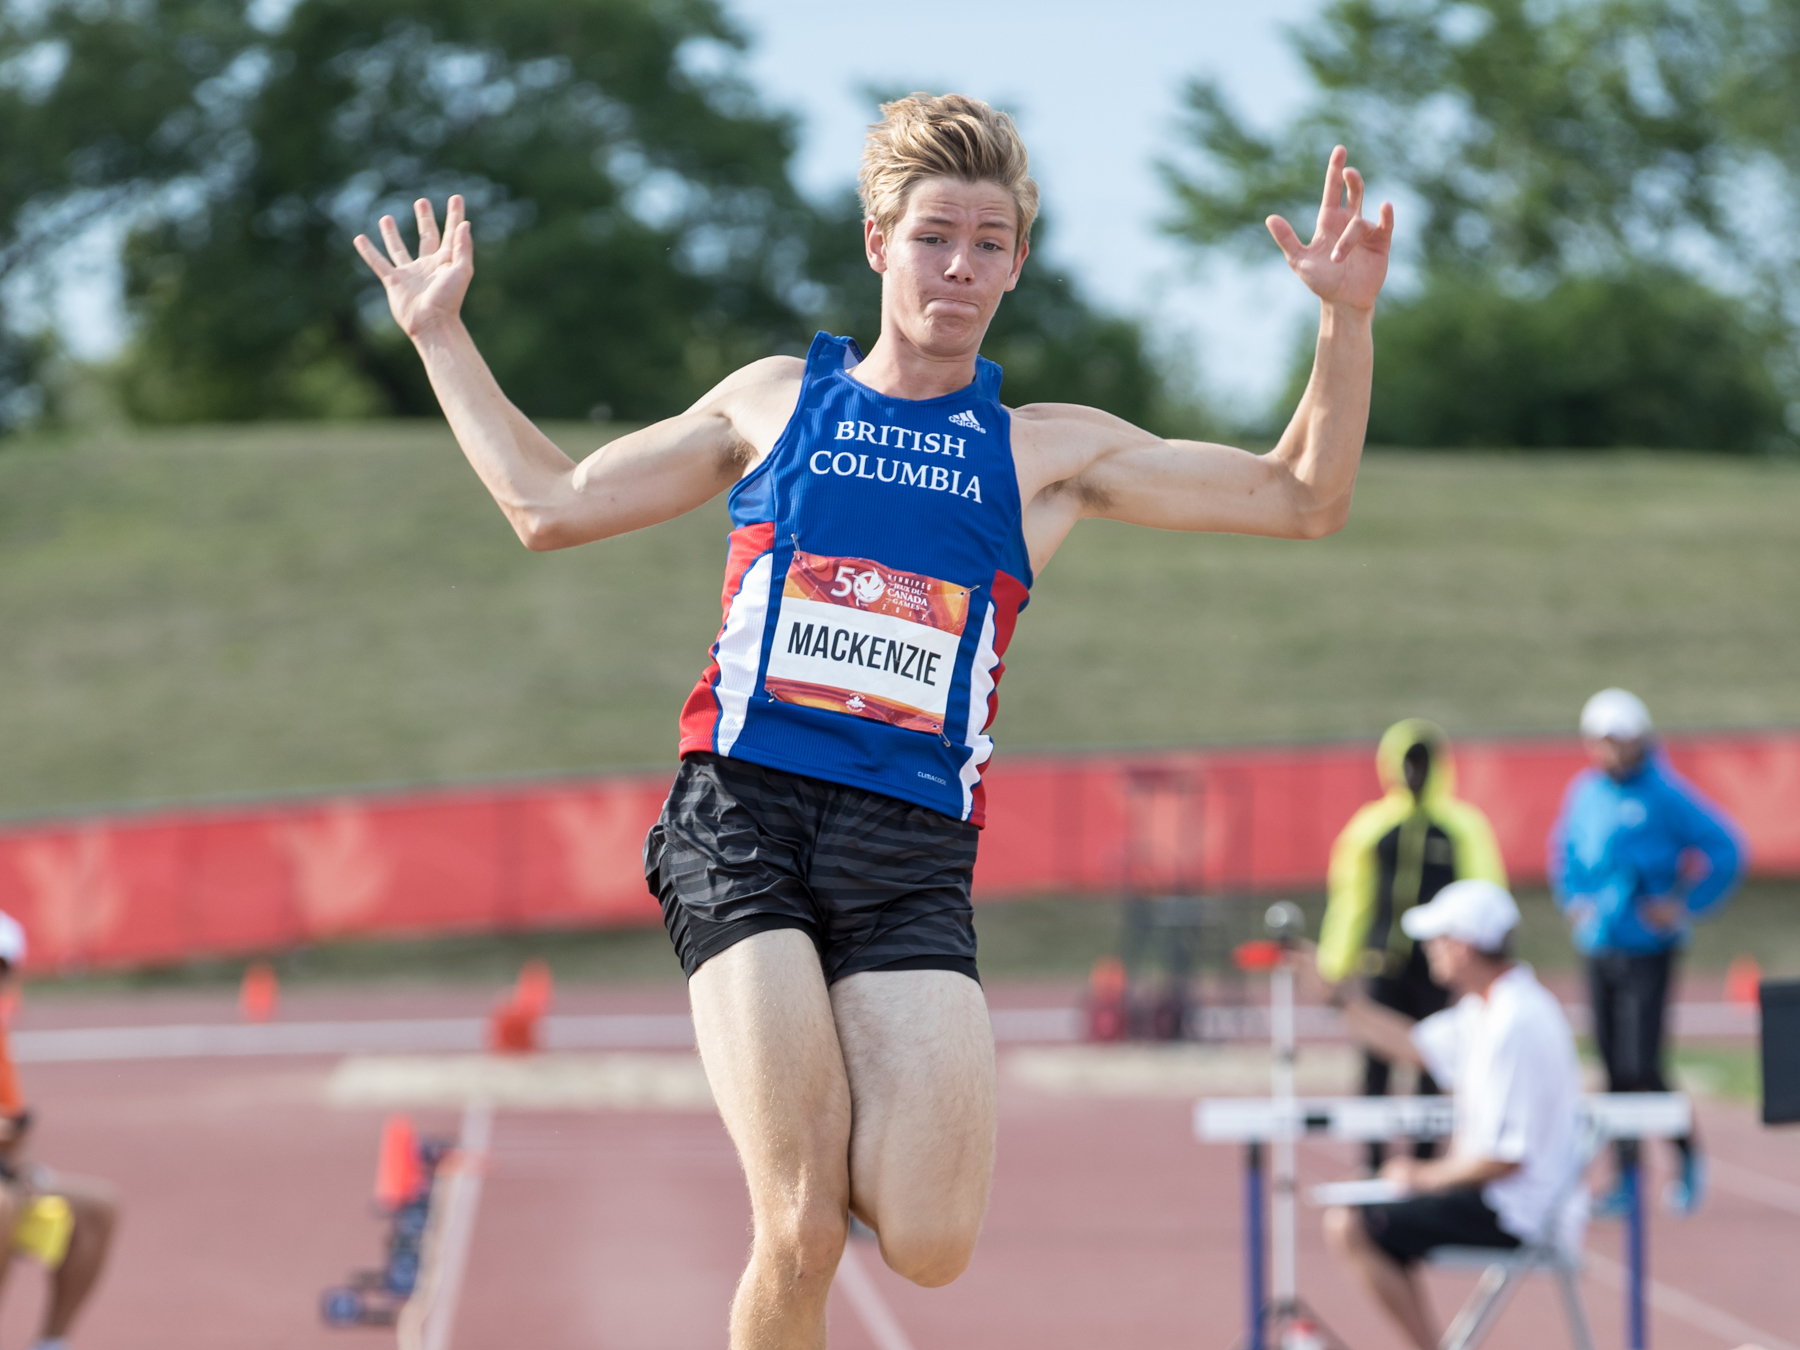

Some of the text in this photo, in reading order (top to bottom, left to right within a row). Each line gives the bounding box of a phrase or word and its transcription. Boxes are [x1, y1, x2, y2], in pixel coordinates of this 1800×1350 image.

[948, 415, 987, 434] adidas
[834, 420, 966, 459] BRITISH
[809, 450, 982, 504] COLUMBIA
[887, 573, 932, 591] WINNIPEG
[893, 583, 922, 596] JEUX DU
[887, 588, 928, 607] CANADA
[892, 598, 920, 611] GAMES
[787, 621, 942, 687] MACKENZIE
